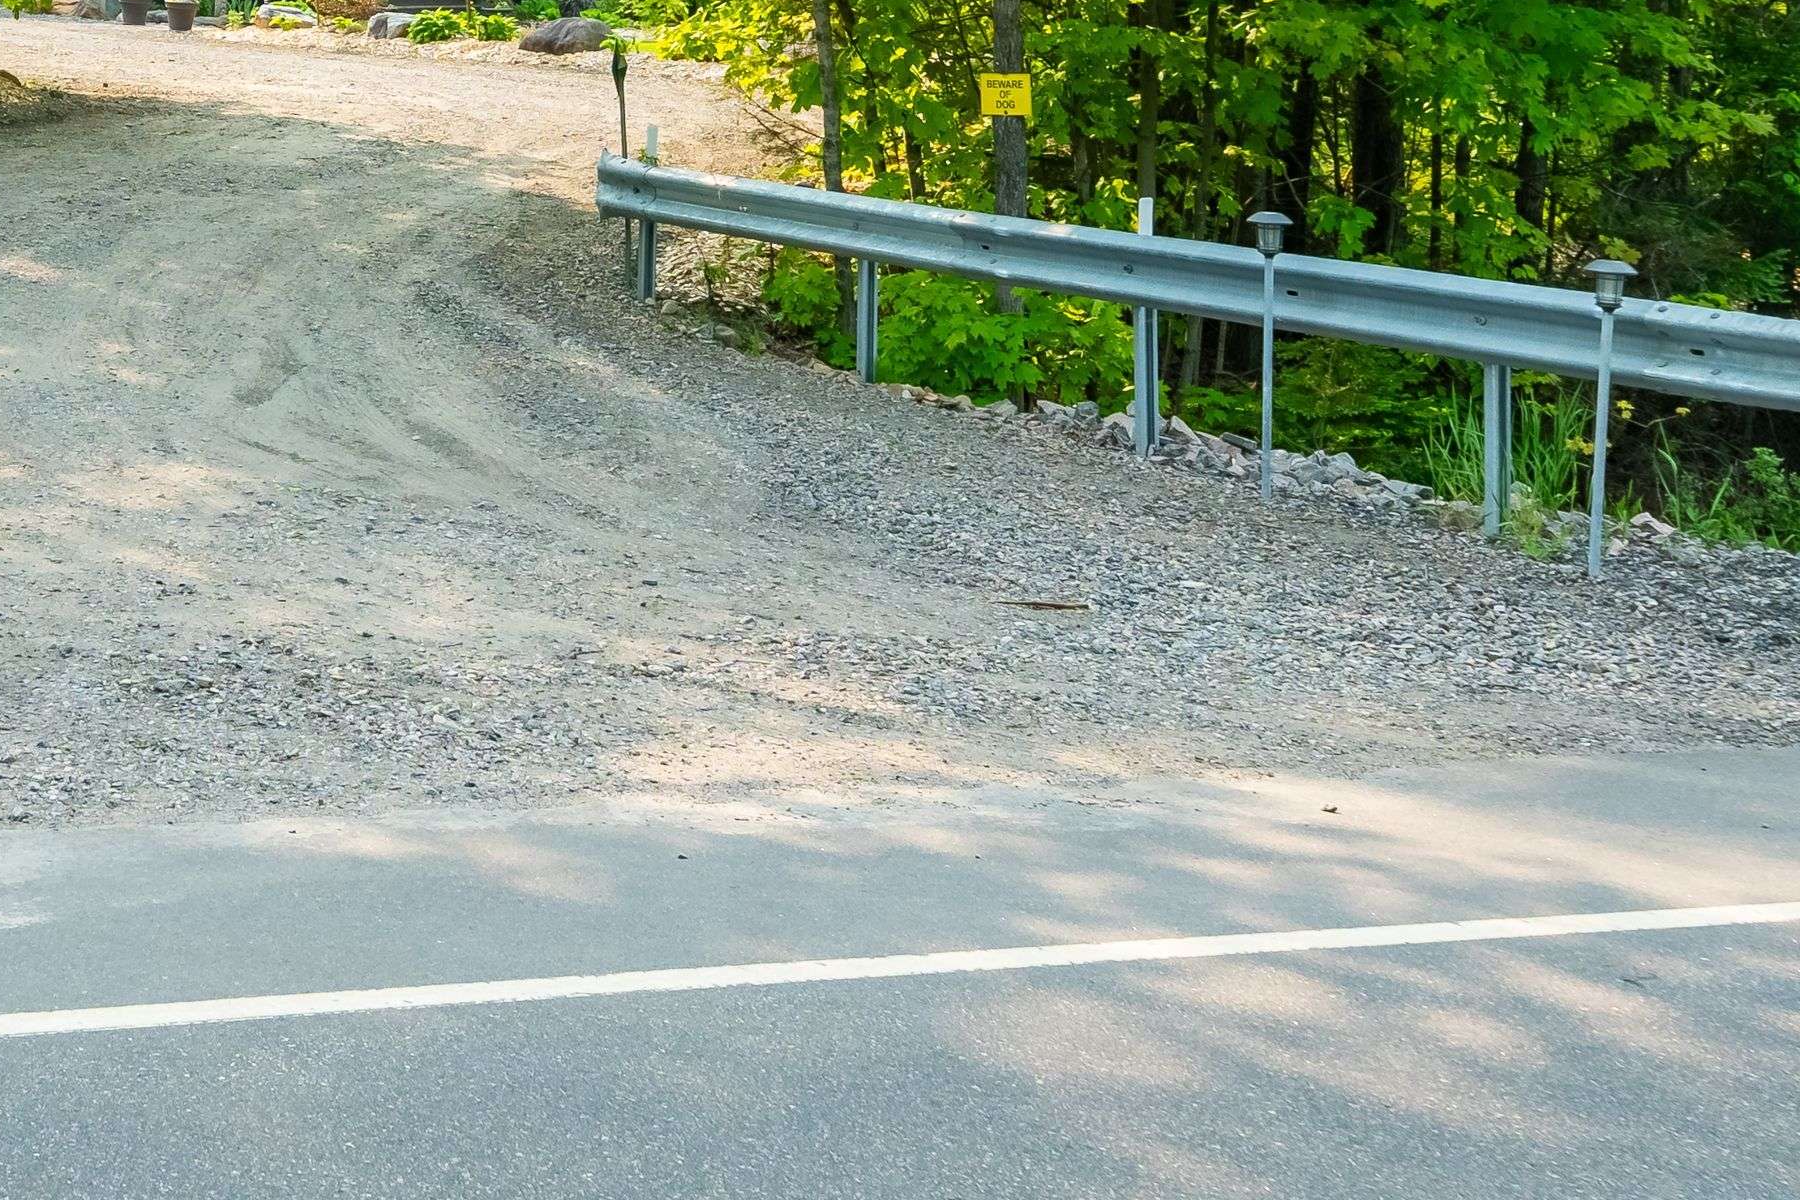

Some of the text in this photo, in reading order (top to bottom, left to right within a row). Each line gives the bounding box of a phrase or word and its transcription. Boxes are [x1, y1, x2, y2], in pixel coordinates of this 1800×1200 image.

[986, 80, 1024, 88] BEWARE
[999, 90, 1012, 99] OF
[995, 100, 1016, 109] DOG
